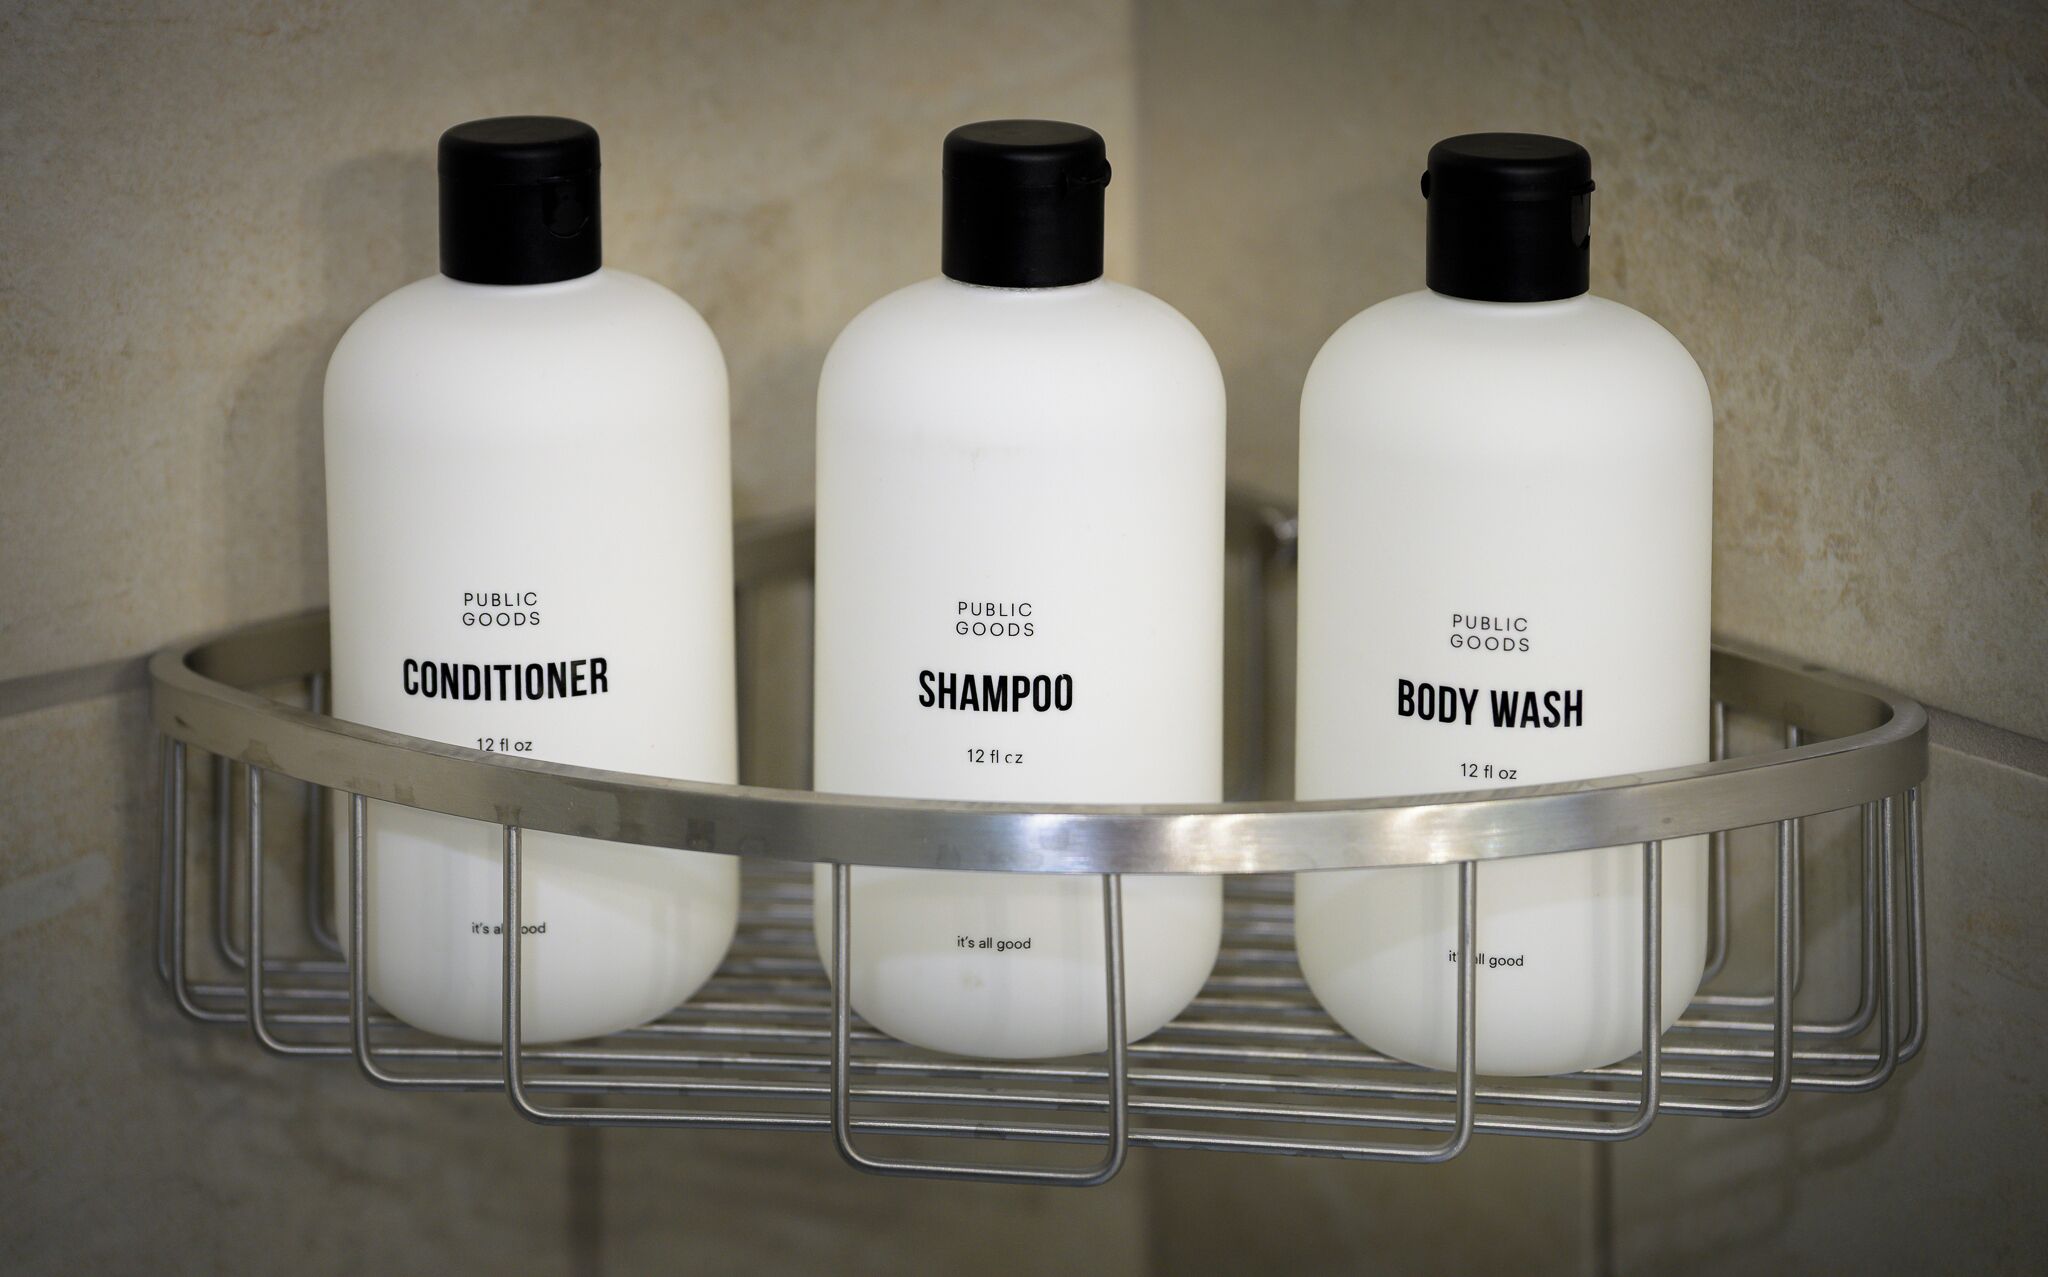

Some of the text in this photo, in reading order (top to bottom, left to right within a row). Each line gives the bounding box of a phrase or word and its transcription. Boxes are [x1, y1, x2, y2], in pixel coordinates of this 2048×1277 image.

[463, 591, 538, 607] PUBLIC
[958, 601, 1032, 617] PUBLIC
[462, 611, 541, 627] GOODS
[1452, 613, 1528, 632] PUBLIC
[955, 621, 1034, 637] GOODS
[1450, 633, 1530, 652] GOODS
[402, 656, 609, 702] CONDITIONER
[918, 669, 1073, 713] SHAMPOO
[1398, 678, 1583, 729] BODY WASH
[477, 737, 533, 752] 12 fl oz
[967, 748, 985, 764] 12
[989, 749, 999, 764] fl
[1460, 762, 1517, 780] 12 fl oz
[471, 922, 490, 935] it's
[957, 935, 1032, 953] it's all good
[1488, 954, 1524, 969] good
